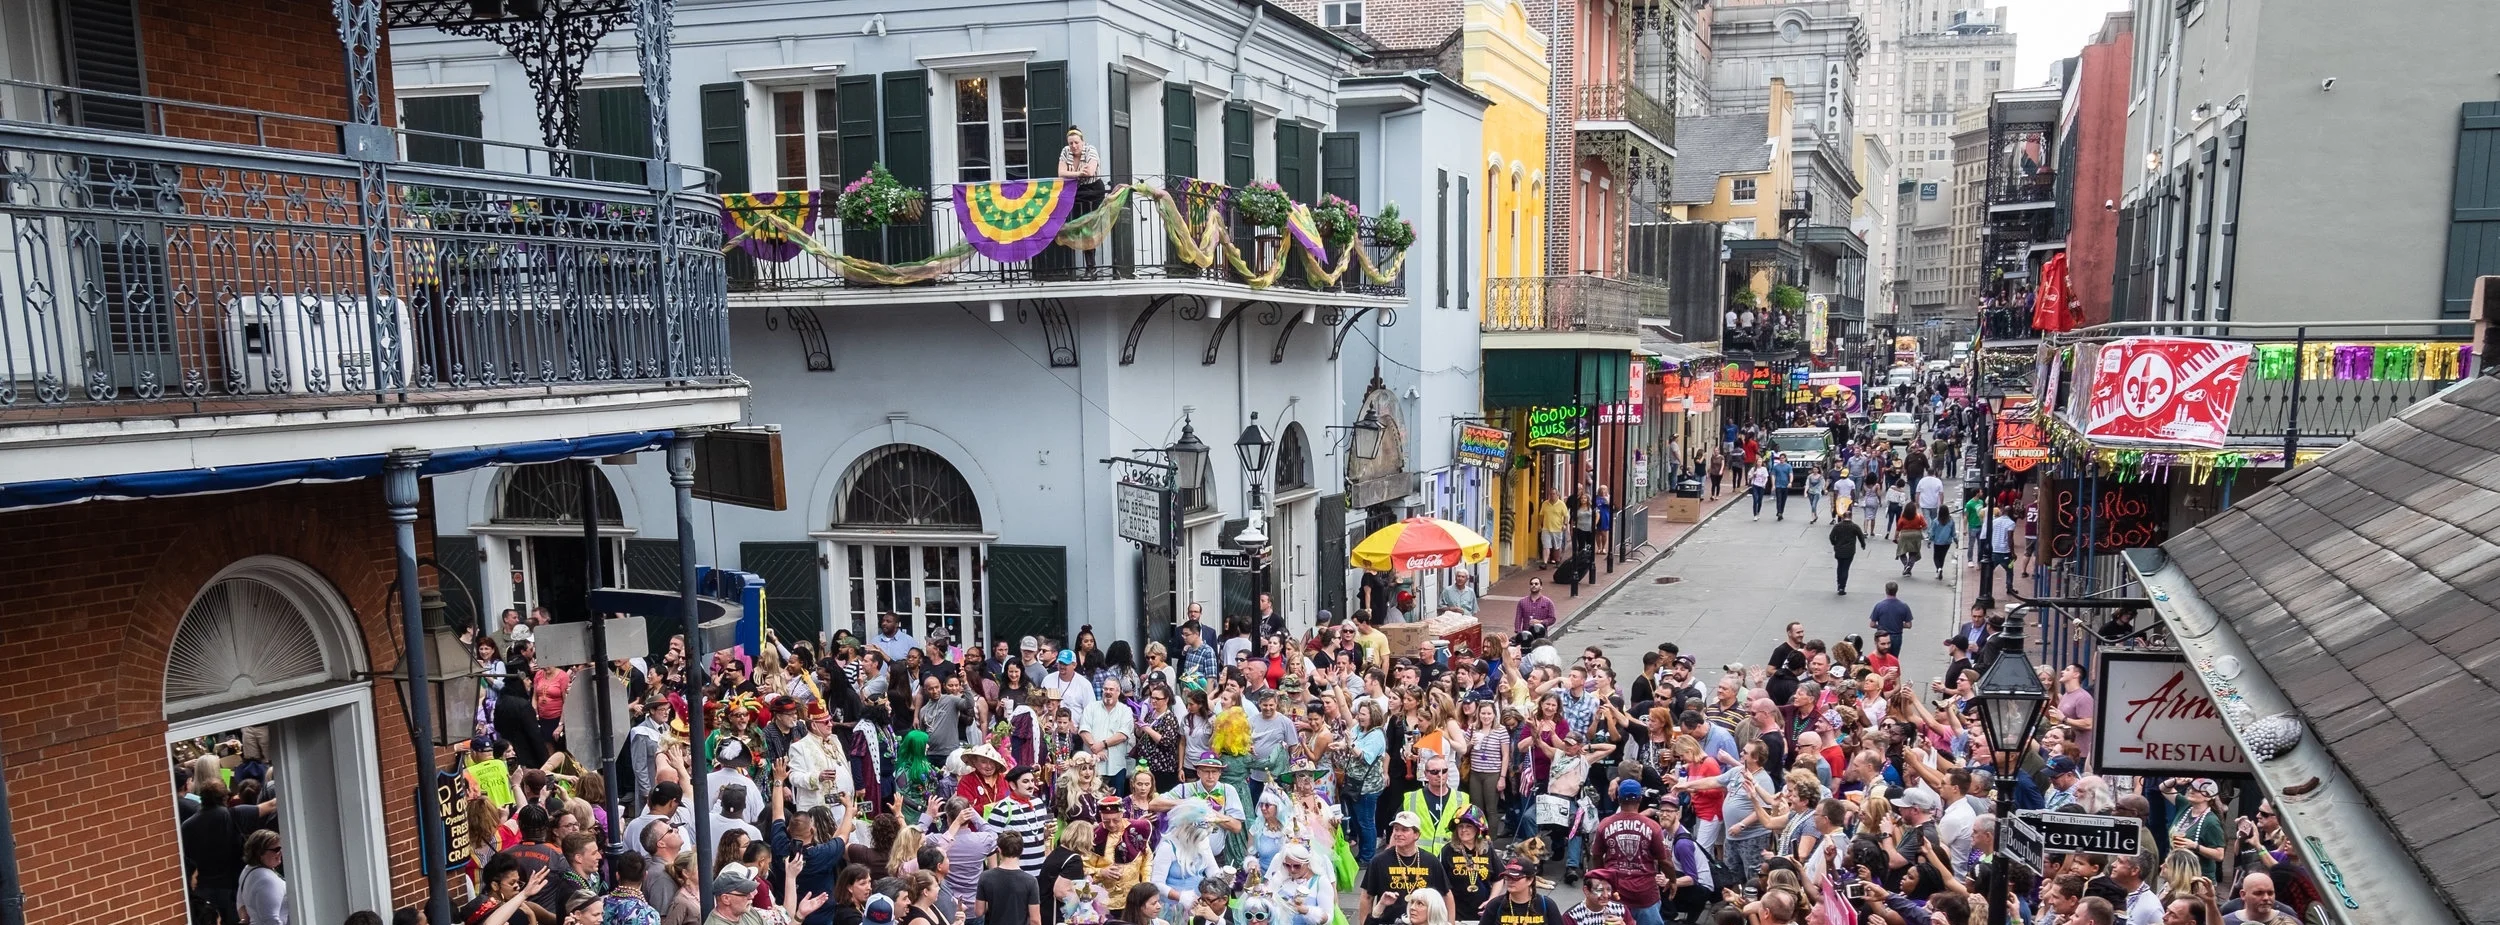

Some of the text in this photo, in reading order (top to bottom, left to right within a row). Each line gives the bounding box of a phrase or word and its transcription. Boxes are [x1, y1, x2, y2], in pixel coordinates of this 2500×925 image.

[1828, 64, 1838, 132] ASTOR
[1923, 184, 1936, 192] AC
[1467, 427, 1502, 439] MANGO
[1532, 421, 1565, 438] BLUES
[1461, 434, 1508, 451] MANGO
[1462, 457, 1500, 470] BREW PUB
[1636, 478, 1646, 486] $20
[1119, 498, 1159, 521] OLD ABSINTHE
[2027, 512, 2039, 522] 27
[1129, 516, 1150, 534] HOUSE
[1124, 529, 1140, 539] SINCE
[1201, 555, 1249, 567] Bienville
[2050, 815, 2107, 826] Rue Bienville
[1604, 819, 1653, 841] AMERICAN
[2040, 825, 2136, 851] ienville
[2007, 827, 2042, 869] Bourbon
[1520, 915, 1544, 924] POLICE
